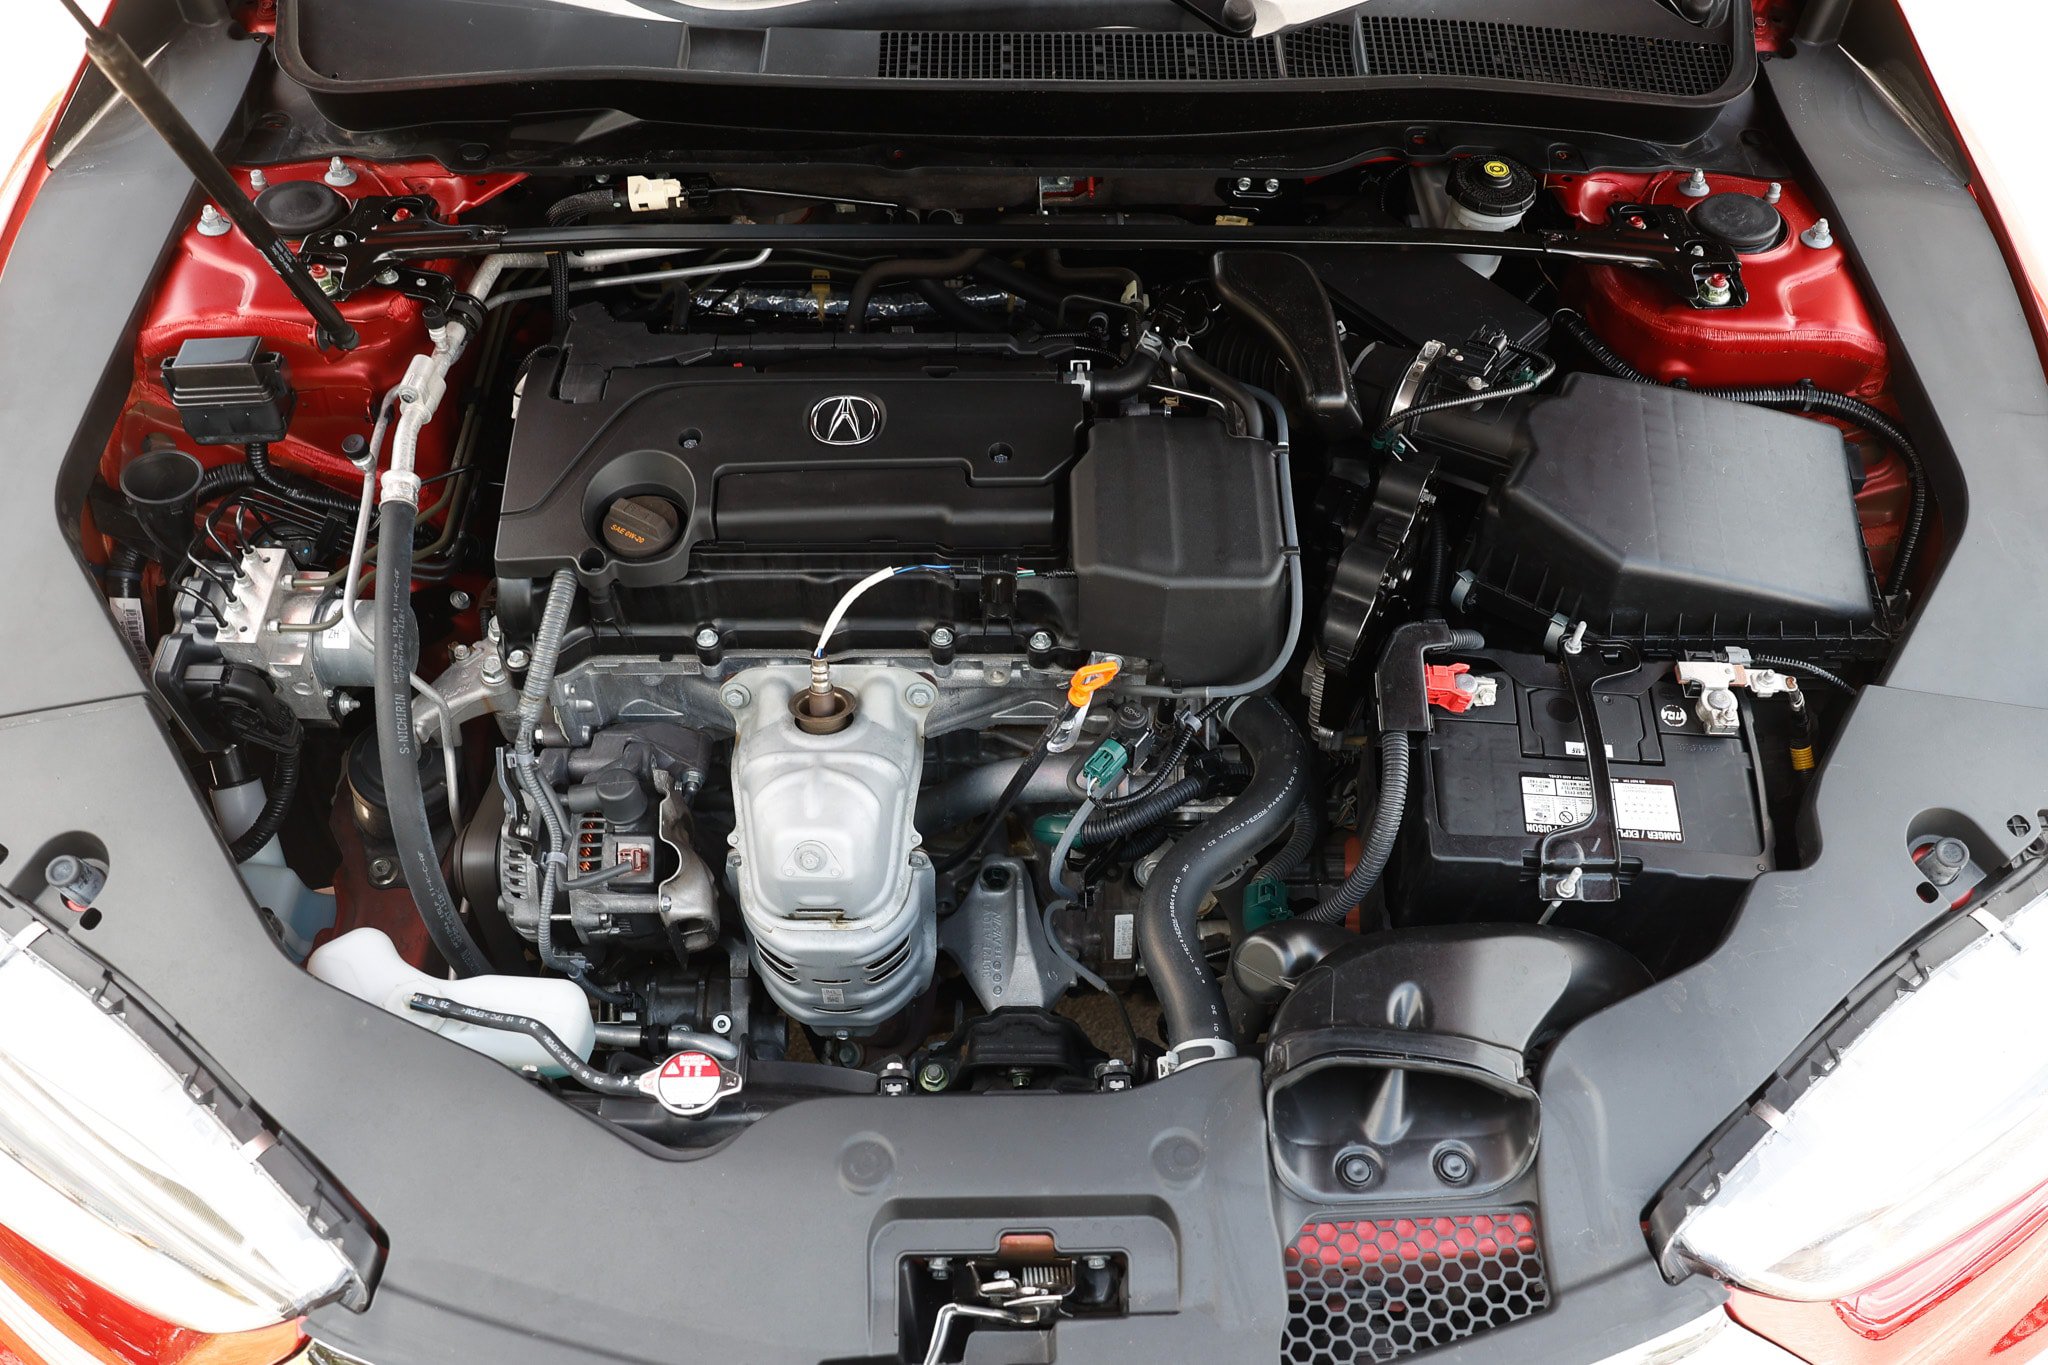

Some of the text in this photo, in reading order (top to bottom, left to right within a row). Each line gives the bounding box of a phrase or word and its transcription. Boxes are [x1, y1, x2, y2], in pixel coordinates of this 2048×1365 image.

[610, 524, 645, 544] SAE 0W-20
[1526, 823, 1556, 833] OISON
[1648, 832, 1682, 841] DANGER
[490, 1014, 504, 1022] TPC
